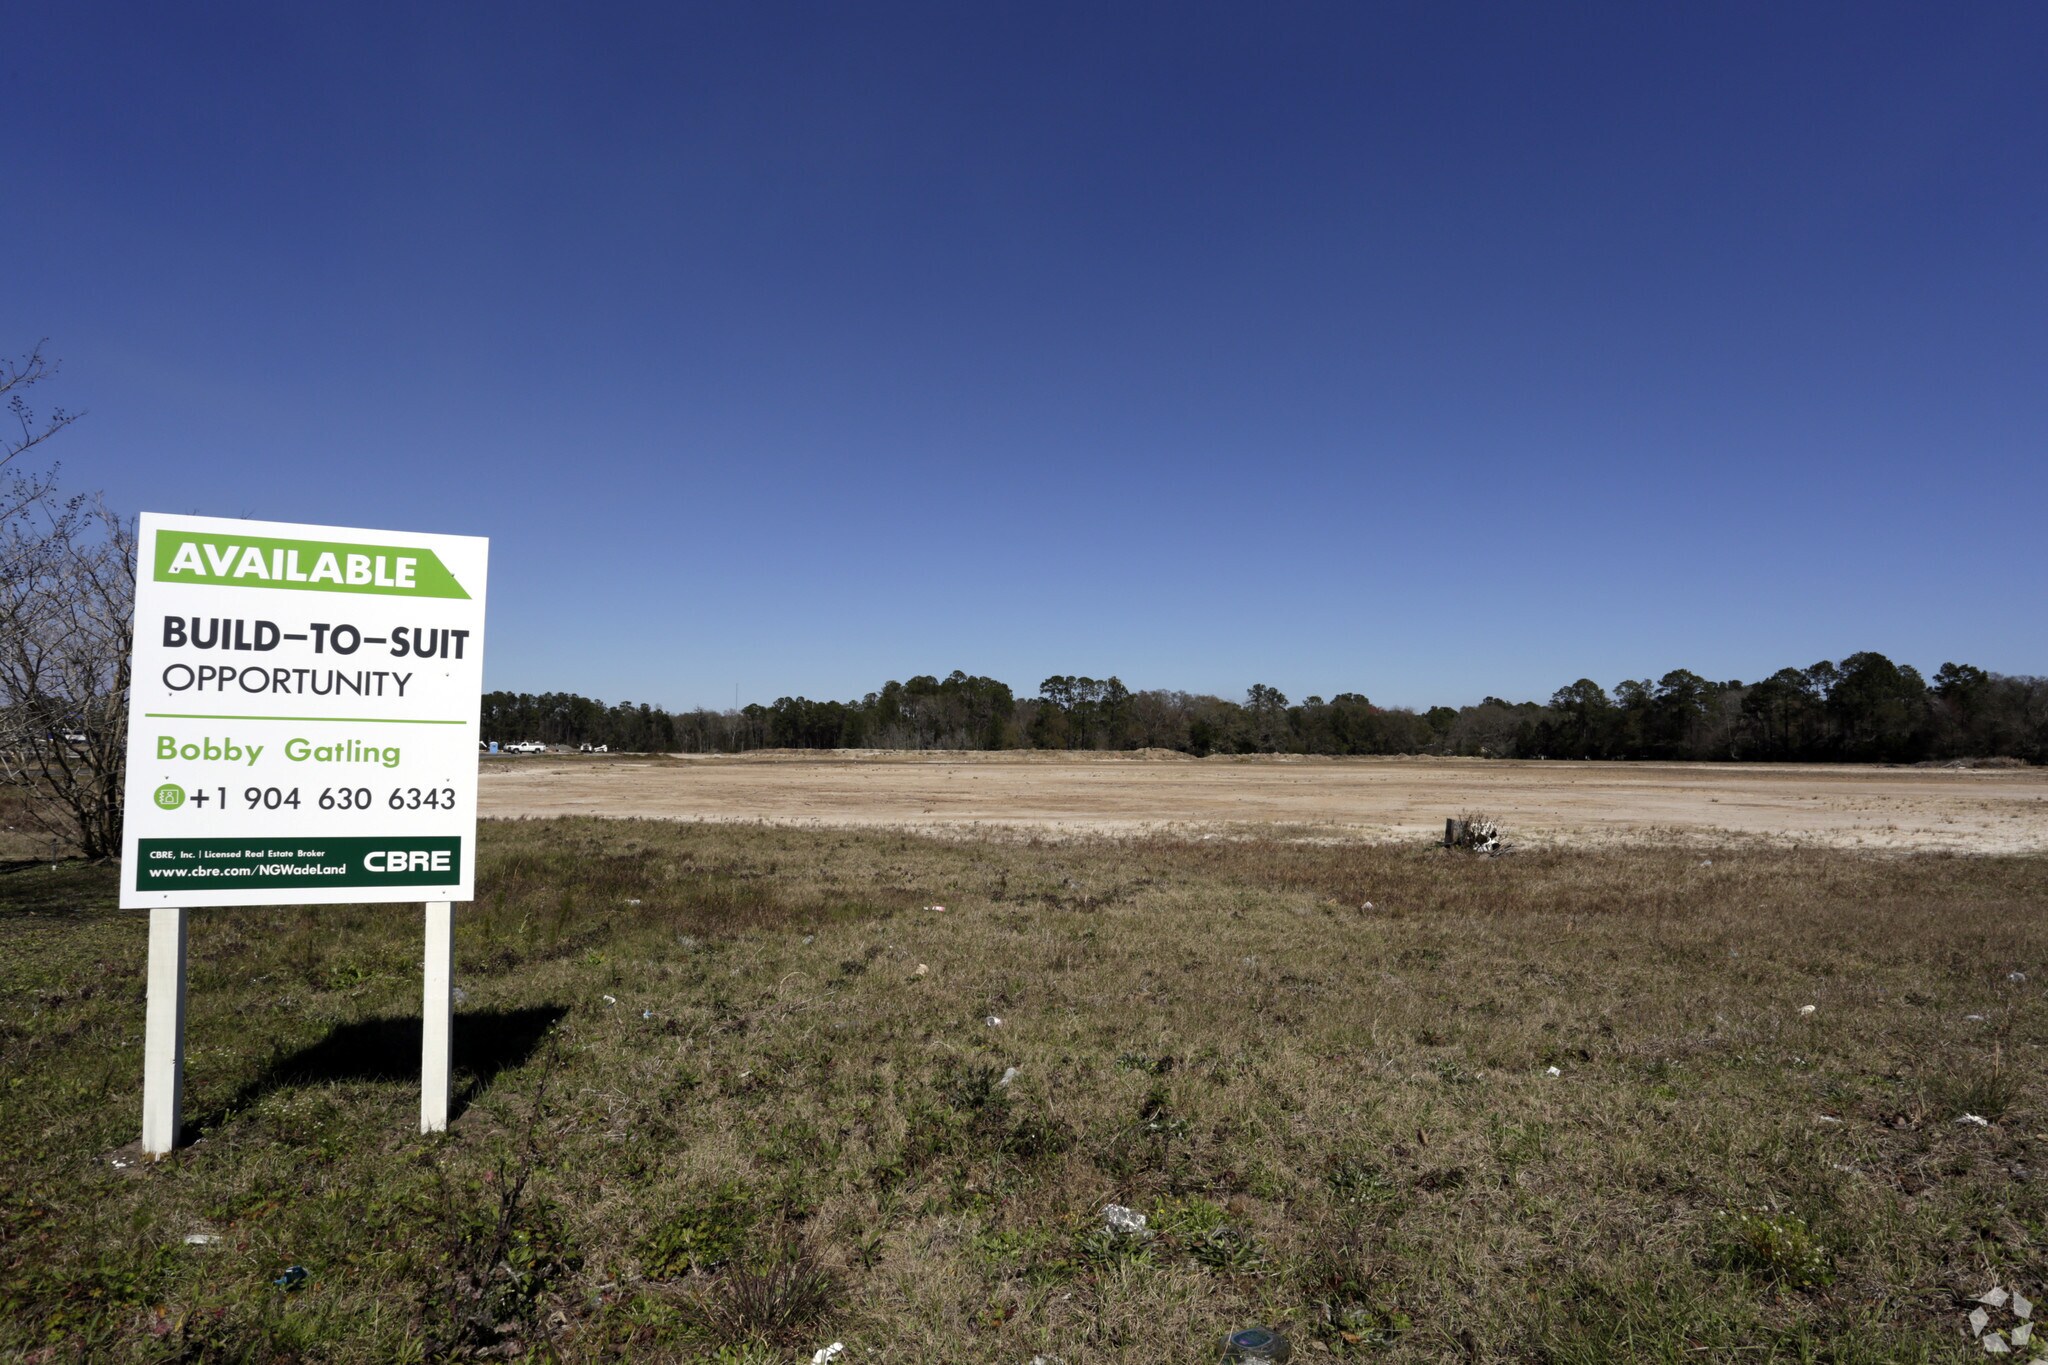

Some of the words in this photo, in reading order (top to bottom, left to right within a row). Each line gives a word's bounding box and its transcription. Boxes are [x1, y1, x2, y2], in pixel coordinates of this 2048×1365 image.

[168, 541, 417, 589] AVAILABLE
[162, 663, 413, 697] OPPORTUNITY
[156, 735, 264, 766] Bobby
[284, 738, 401, 768] Gatling
[190, 787, 226, 810] +1
[244, 787, 301, 810] 904
[318, 788, 372, 810] 630
[388, 788, 456, 810] 6343
[149, 850, 177, 860] CBRE,
[180, 850, 196, 858] Inc.
[204, 849, 241, 858] Licensed
[245, 849, 264, 858] Real
[268, 849, 294, 858] Estate
[297, 848, 325, 858] Broker
[363, 850, 451, 872] CBRE
[149, 862, 346, 878] www.cbre.com/NGWadeLand
